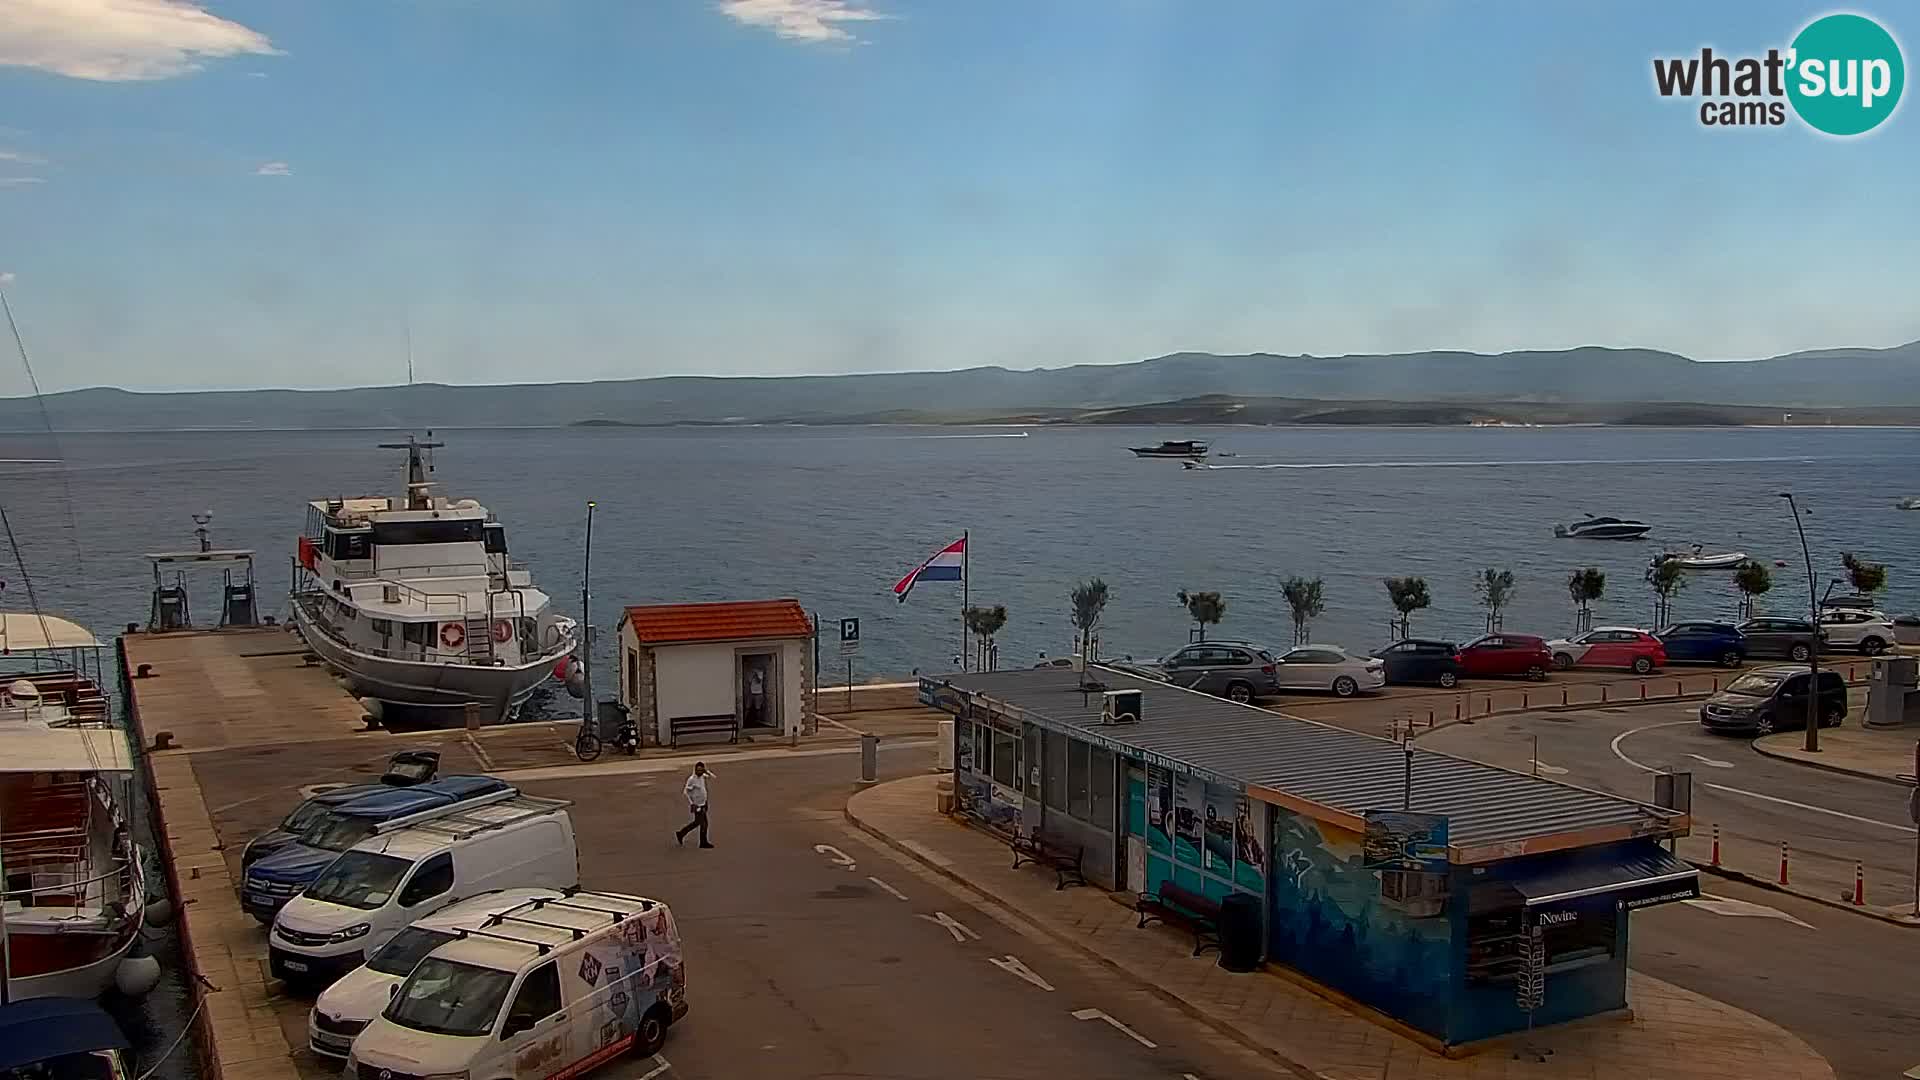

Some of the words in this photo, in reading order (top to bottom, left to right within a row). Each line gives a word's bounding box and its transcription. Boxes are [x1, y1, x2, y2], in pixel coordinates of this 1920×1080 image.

[844, 621, 855, 638] P
[1143, 751, 1157, 764] BUS
[1157, 756, 1188, 774] STATION
